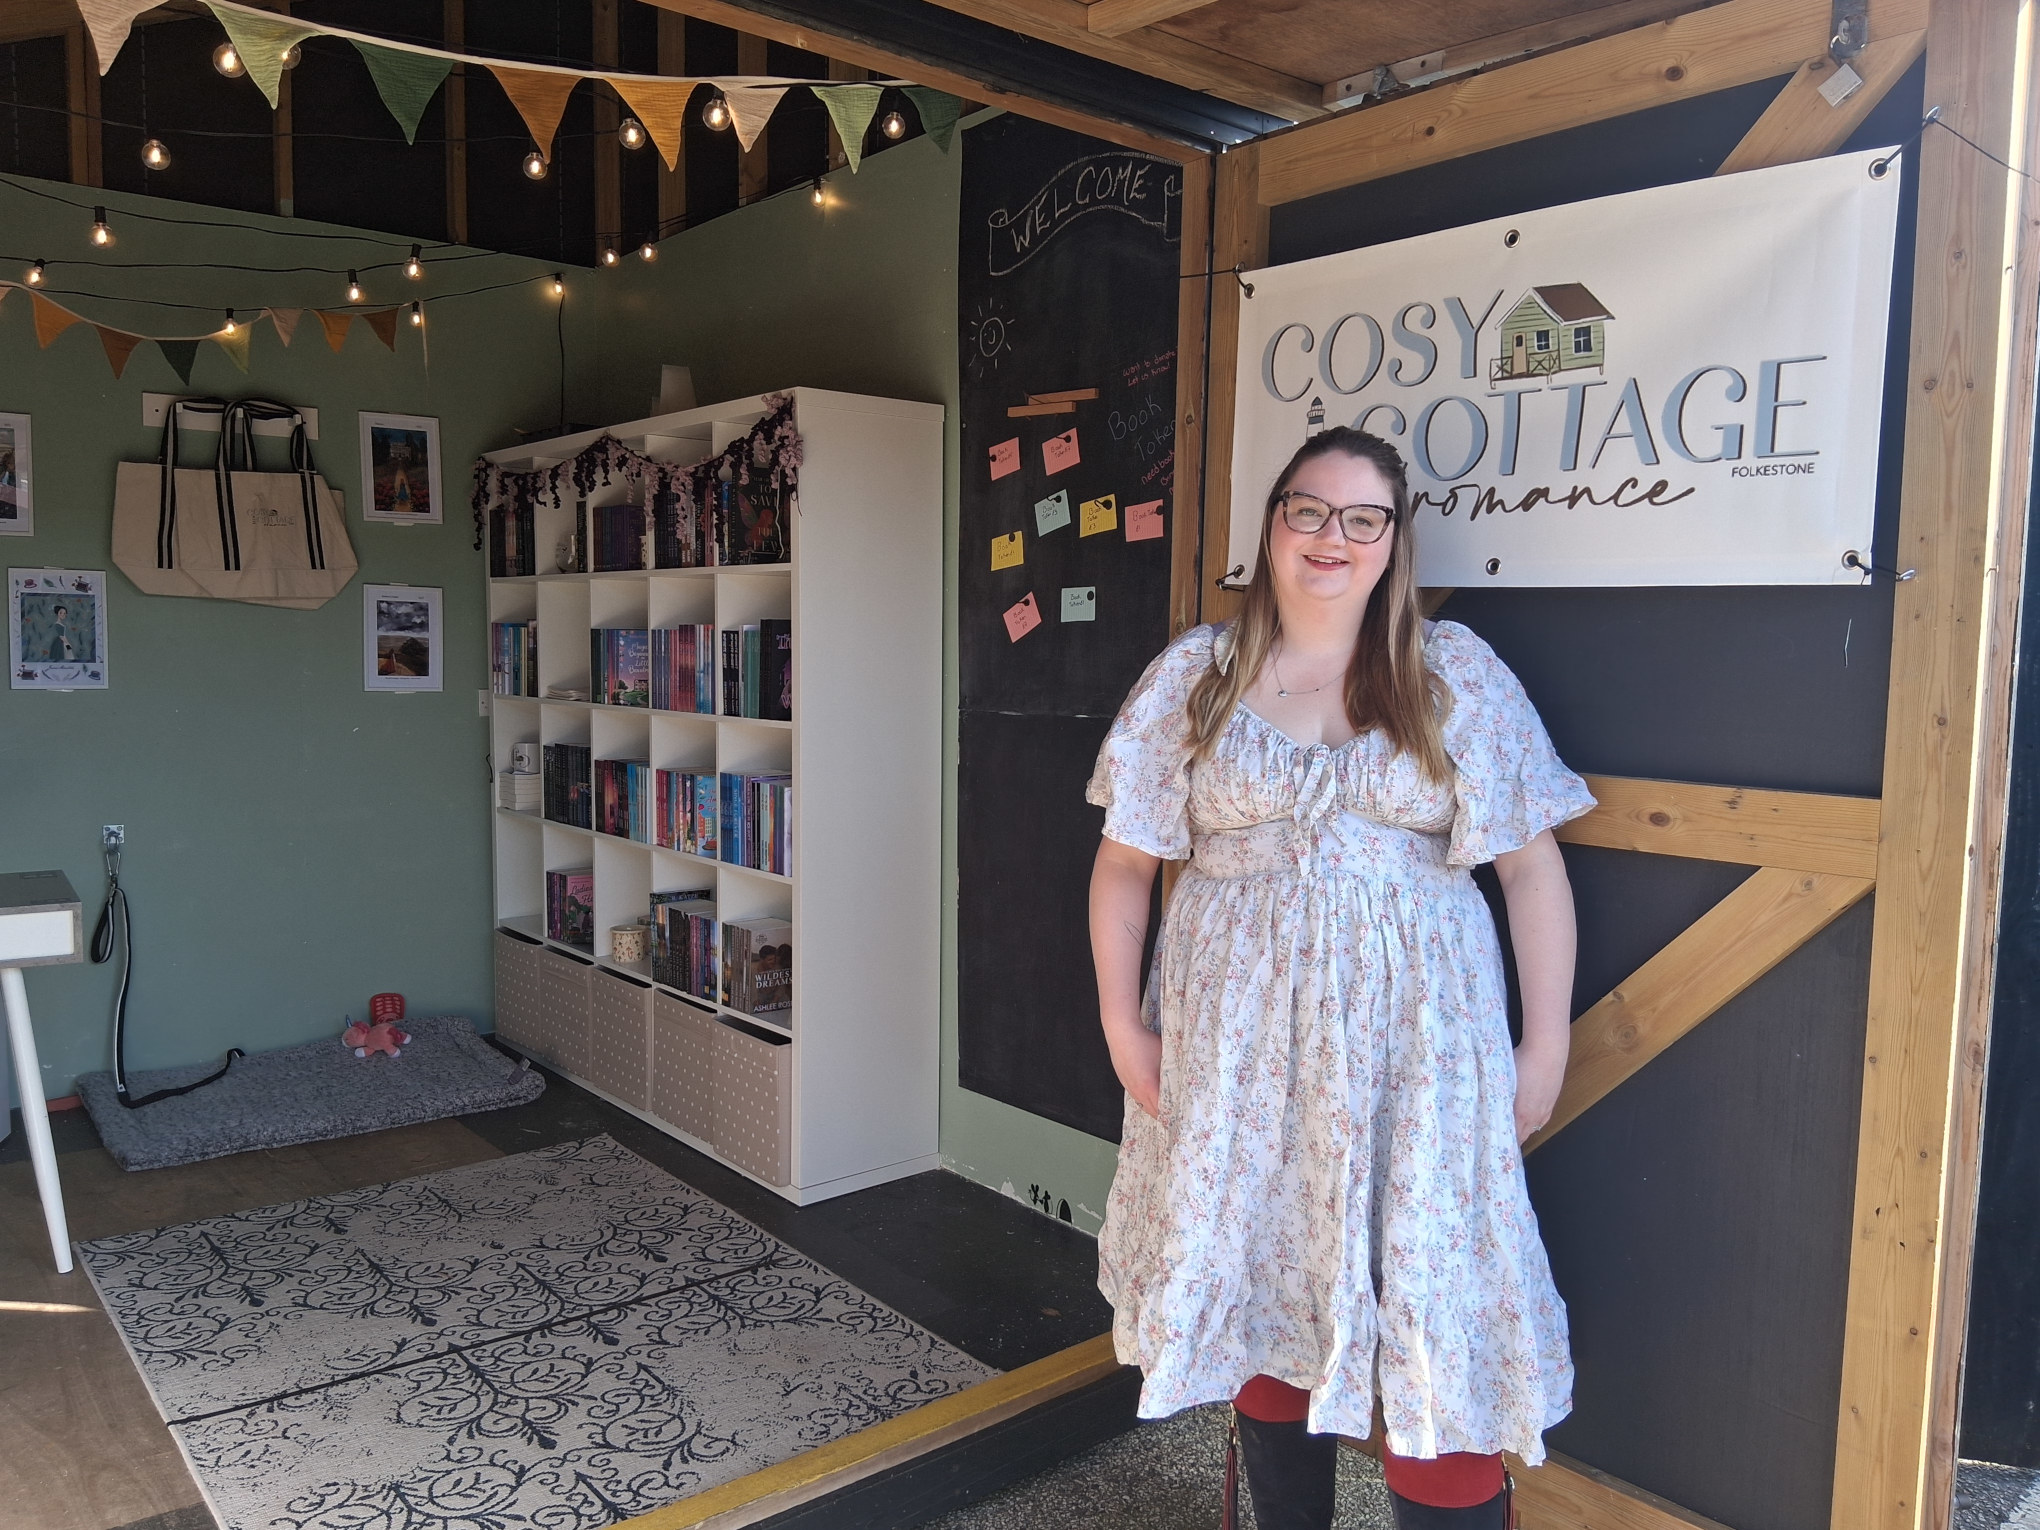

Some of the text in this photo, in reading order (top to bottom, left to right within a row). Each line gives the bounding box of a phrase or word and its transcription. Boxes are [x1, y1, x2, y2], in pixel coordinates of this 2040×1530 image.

[1011, 160, 1152, 253] WELCOME
[1261, 289, 1504, 402] COSY
[1107, 394, 1162, 441] Book
[1731, 462, 1815, 478] FOLKESTONE
[1411, 474, 1695, 521] romance
[755, 970, 792, 982] WILDES
[778, 1000, 792, 1009] ROS
